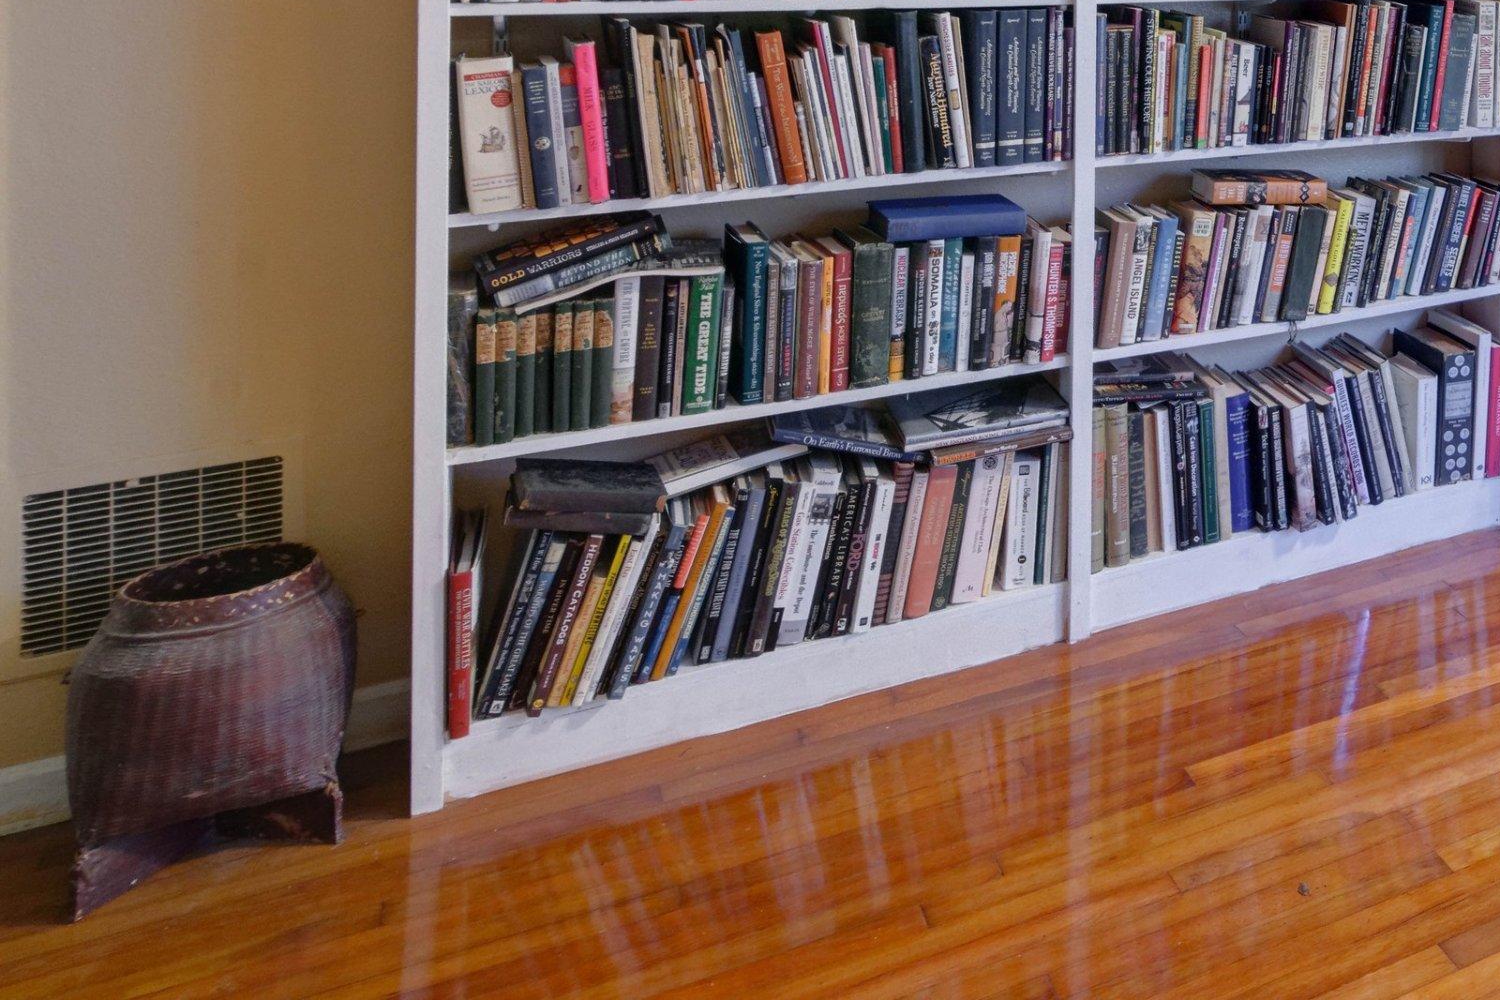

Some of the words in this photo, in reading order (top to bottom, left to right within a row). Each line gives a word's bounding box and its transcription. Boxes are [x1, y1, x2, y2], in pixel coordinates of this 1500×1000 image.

[1145, 18, 1155, 66] STAMPING
[1480, 33, 1492, 48] Talk
[930, 52, 947, 98] Martin's
[1242, 58, 1250, 77] Beer
[1479, 49, 1492, 70] about
[1144, 67, 1152, 85] OUR
[1478, 72, 1492, 98] Trouble
[583, 87, 593, 112] MILK
[1143, 87, 1151, 123] HISTORY
[586, 120, 597, 152] GLASS
[937, 98, 952, 148] Hundred
[1395, 200, 1406, 218] BIG
[1458, 185, 1471, 208] DANIEL
[1232, 217, 1246, 259] Redemption
[1388, 219, 1403, 250] BURN
[1451, 210, 1465, 243] ELLSBERG
[1345, 213, 1370, 287] METALWORKING
[1446, 247, 1459, 276] SECRETS
[492, 270, 525, 287] GOLD
[527, 249, 582, 274] WARRIORS
[897, 255, 906, 288] NUCLEAR
[1049, 262, 1060, 295] HUNTER
[1132, 257, 1144, 286] ANGEL
[753, 276, 761, 298] England
[1048, 296, 1057, 304] S.
[700, 293, 712, 318] THE
[753, 299, 761, 315] Silver
[896, 289, 905, 328] NEBRASKA
[1128, 288, 1140, 319] ISLAND
[697, 321, 710, 362] GREAT
[751, 322, 760, 362] Silversmithing
[1044, 306, 1056, 351] THOMPSON
[694, 364, 707, 394] TIDE
[1336, 378, 1350, 412] GUINNESS
[1342, 414, 1354, 437] WORLD
[804, 435, 817, 445] On
[818, 438, 844, 450] Earth's
[846, 442, 882, 455] Furrowed
[1348, 439, 1360, 468] RECORDS
[796, 512, 805, 526] Gas
[840, 487, 858, 542] AMERICA'S
[788, 528, 802, 555] Station
[824, 514, 840, 560] Tutankhamen
[848, 532, 866, 571] FORD
[576, 544, 597, 587] HEDDON
[778, 557, 795, 600] Collectibles
[831, 546, 846, 587] LIBRARY
[462, 588, 471, 611] CIVIL
[530, 580, 548, 617] WARSHIPS
[640, 573, 667, 628] MAKING
[462, 612, 471, 630] WAR
[525, 618, 534, 629] OF
[555, 590, 582, 646] CATALOGS
[462, 632, 471, 669] BATTLES
[519, 631, 528, 646] THE
[508, 648, 524, 672] GREAT
[499, 673, 512, 696] LAKES
